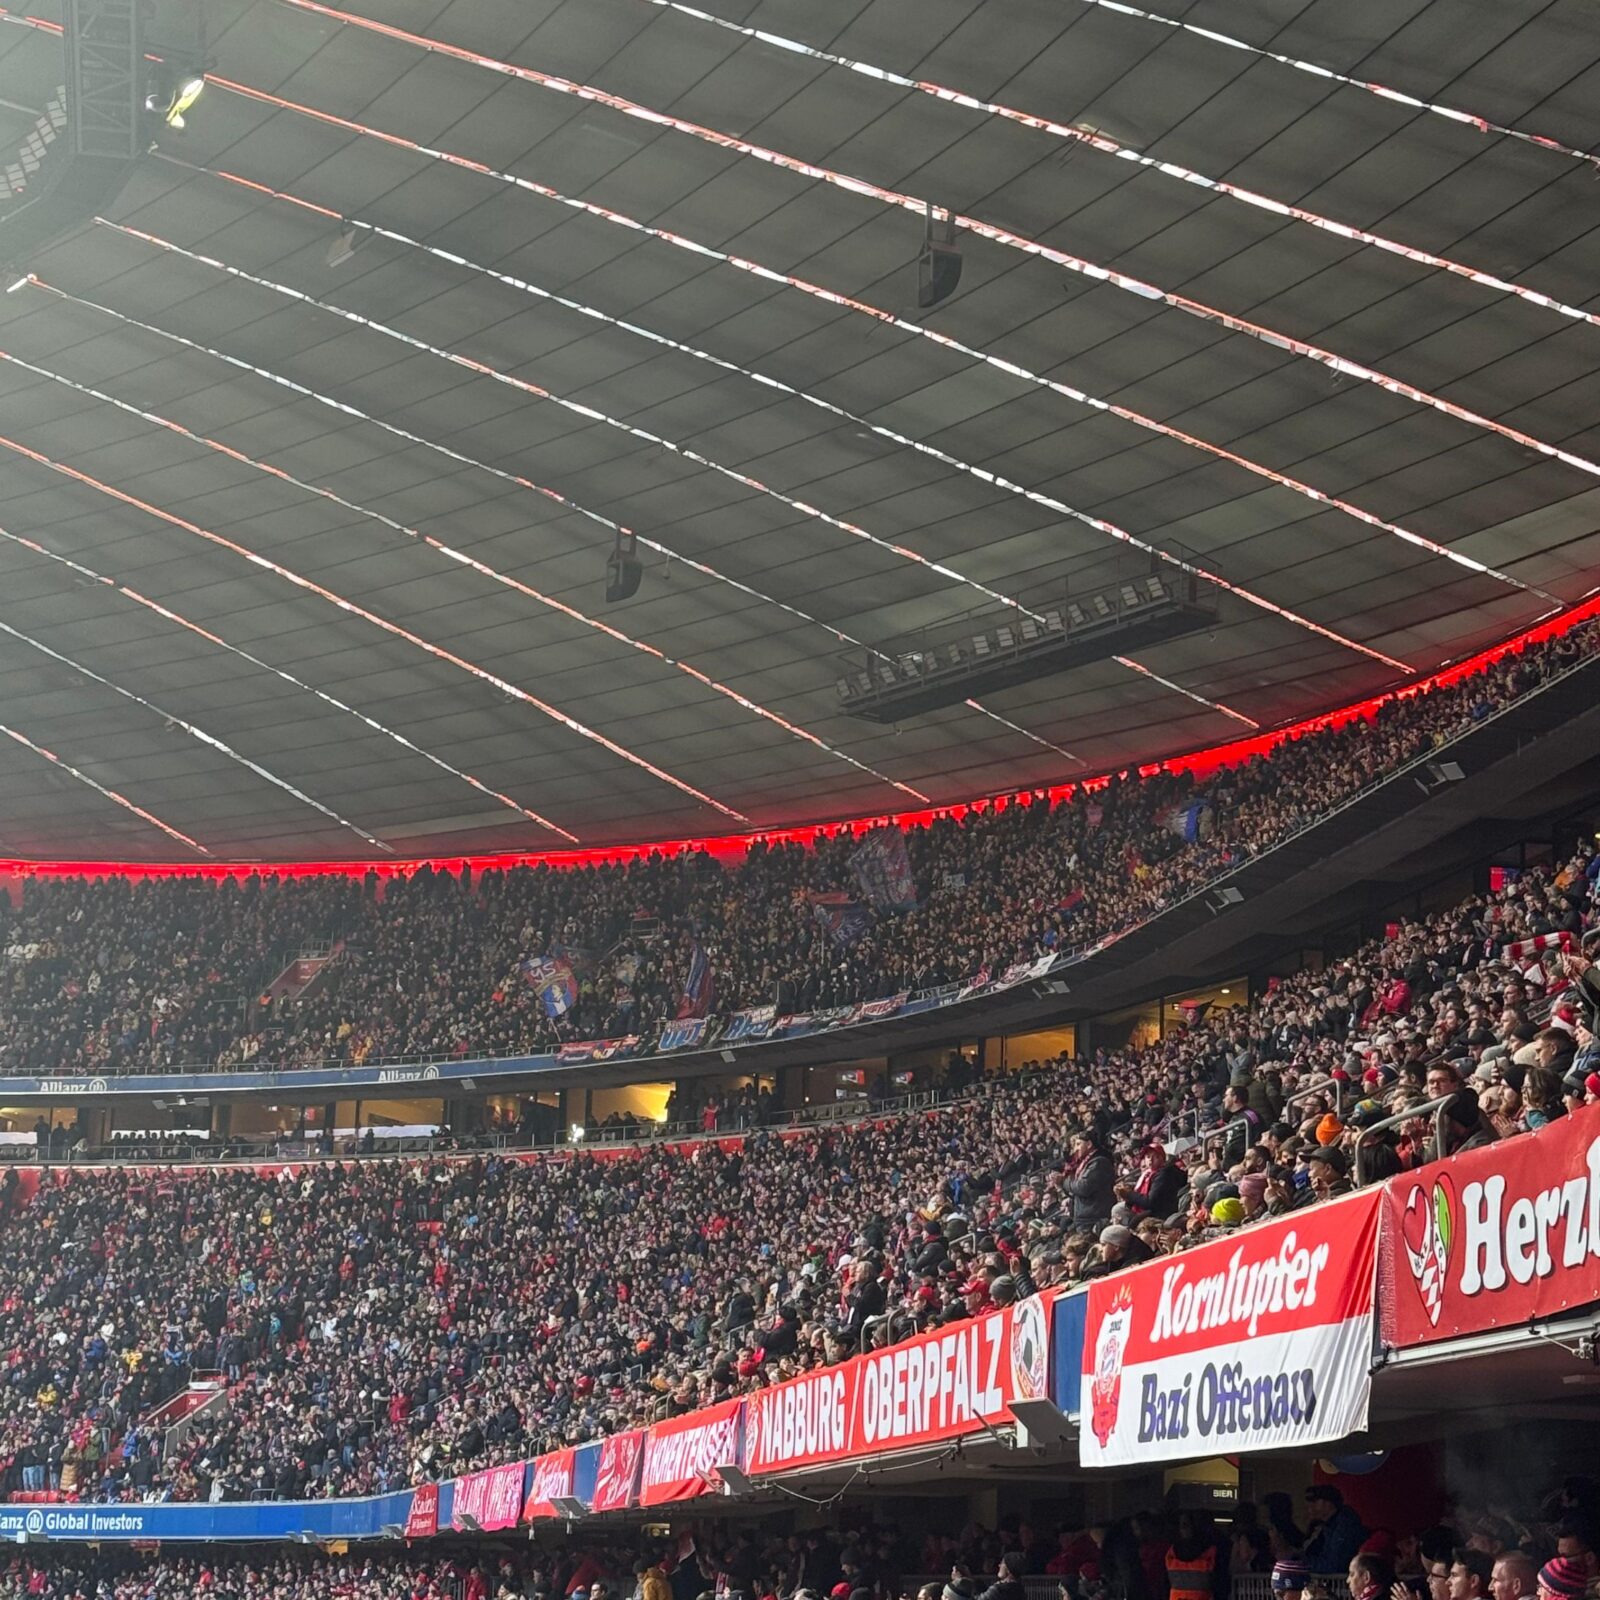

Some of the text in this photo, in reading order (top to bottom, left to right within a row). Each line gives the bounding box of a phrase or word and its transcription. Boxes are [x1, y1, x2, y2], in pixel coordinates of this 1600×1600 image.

[379, 1070, 421, 1083] Allianz
[40, 1081, 87, 1093] Allianz
[1150, 1230, 1330, 1343] Kornlupfer
[758, 1370, 845, 1465] NABBURG
[862, 1314, 1004, 1443] OBERPFALZ
[1137, 1361, 1317, 1443] Bazi Offenau
[1213, 1489, 1233, 1498] BIER
[0, 1512, 143, 1530] anz Global Investors
